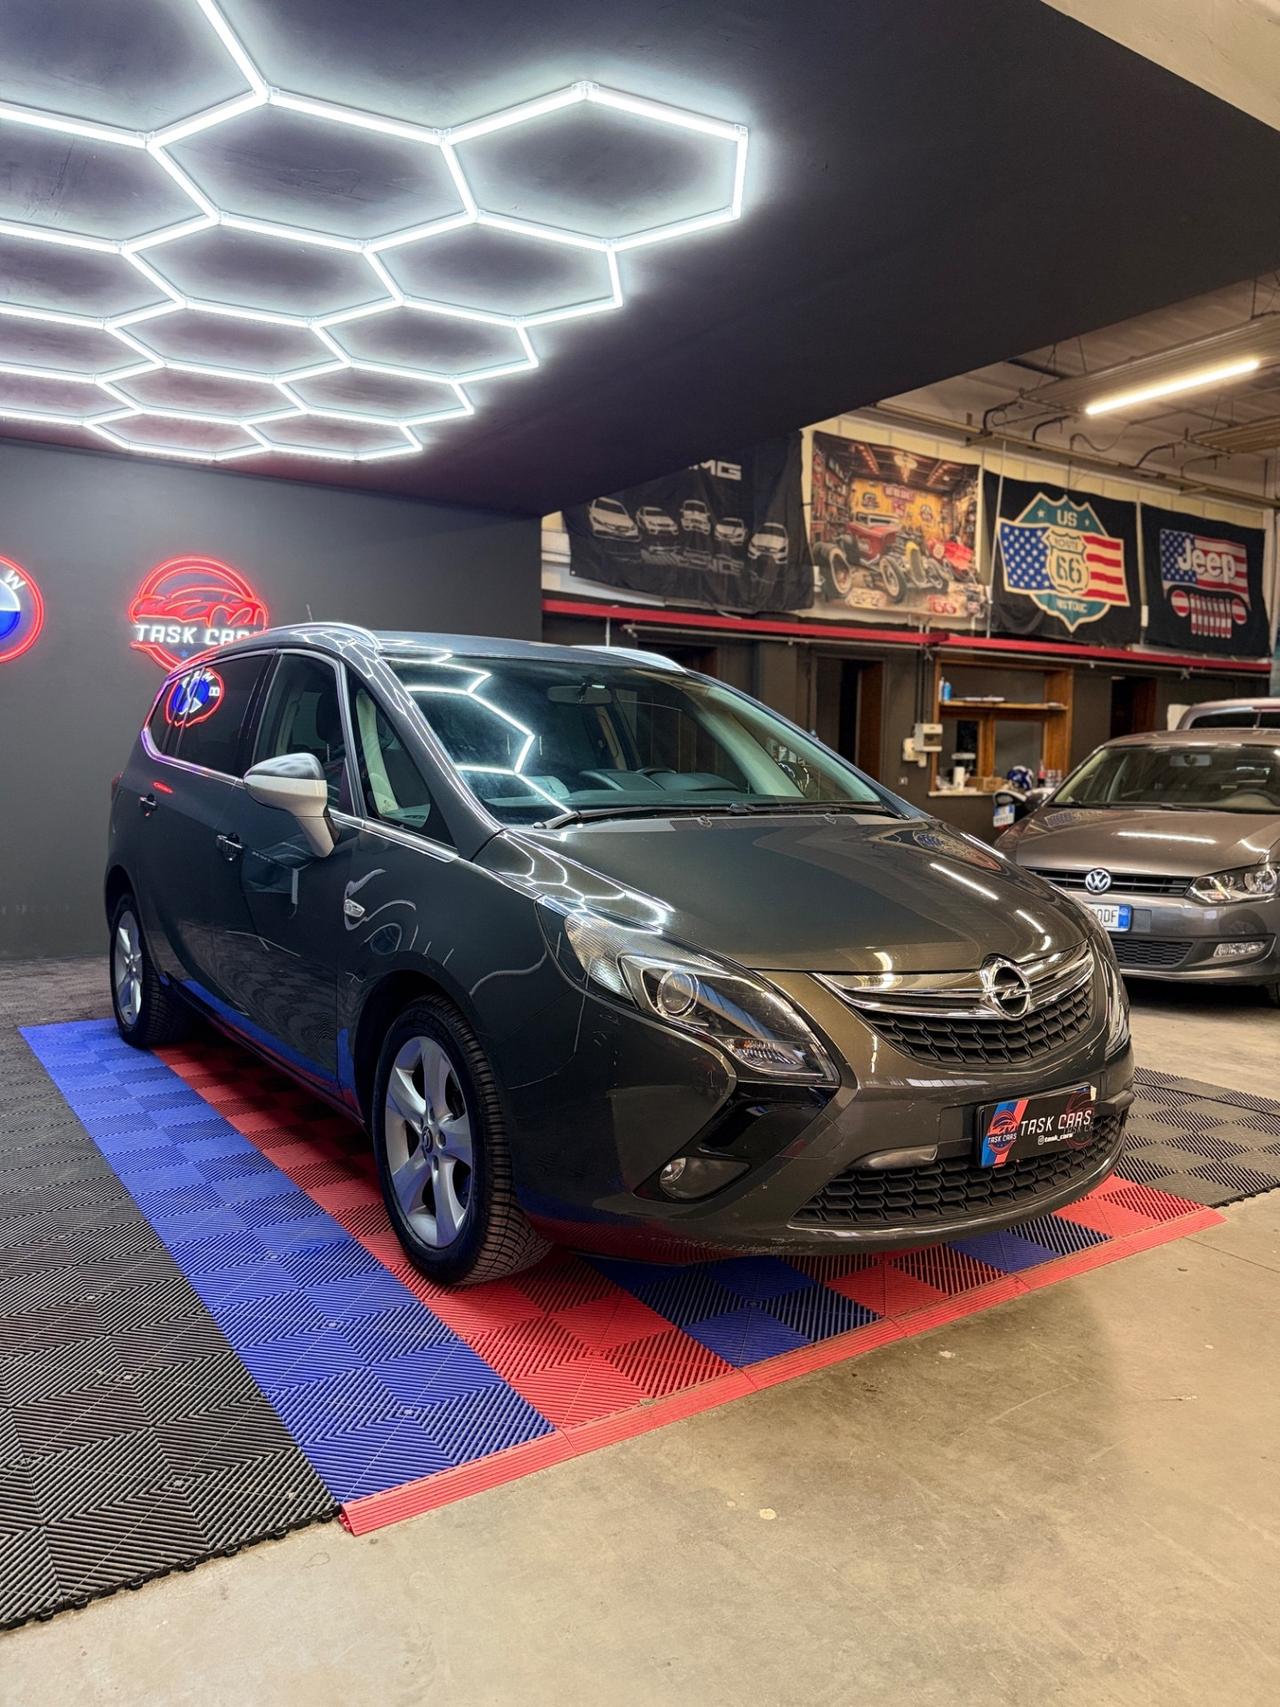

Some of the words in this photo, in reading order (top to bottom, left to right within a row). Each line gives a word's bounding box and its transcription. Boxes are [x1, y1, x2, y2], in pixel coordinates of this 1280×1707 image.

[688, 459, 741, 481] MG
[1057, 508, 1077, 527] US
[1056, 555, 1082, 584] 66
[1177, 537, 1236, 583] Jeep
[134, 624, 197, 644] TASK
[1021, 1116, 1055, 1137] TASK
[1057, 1109, 1092, 1130] CARS
